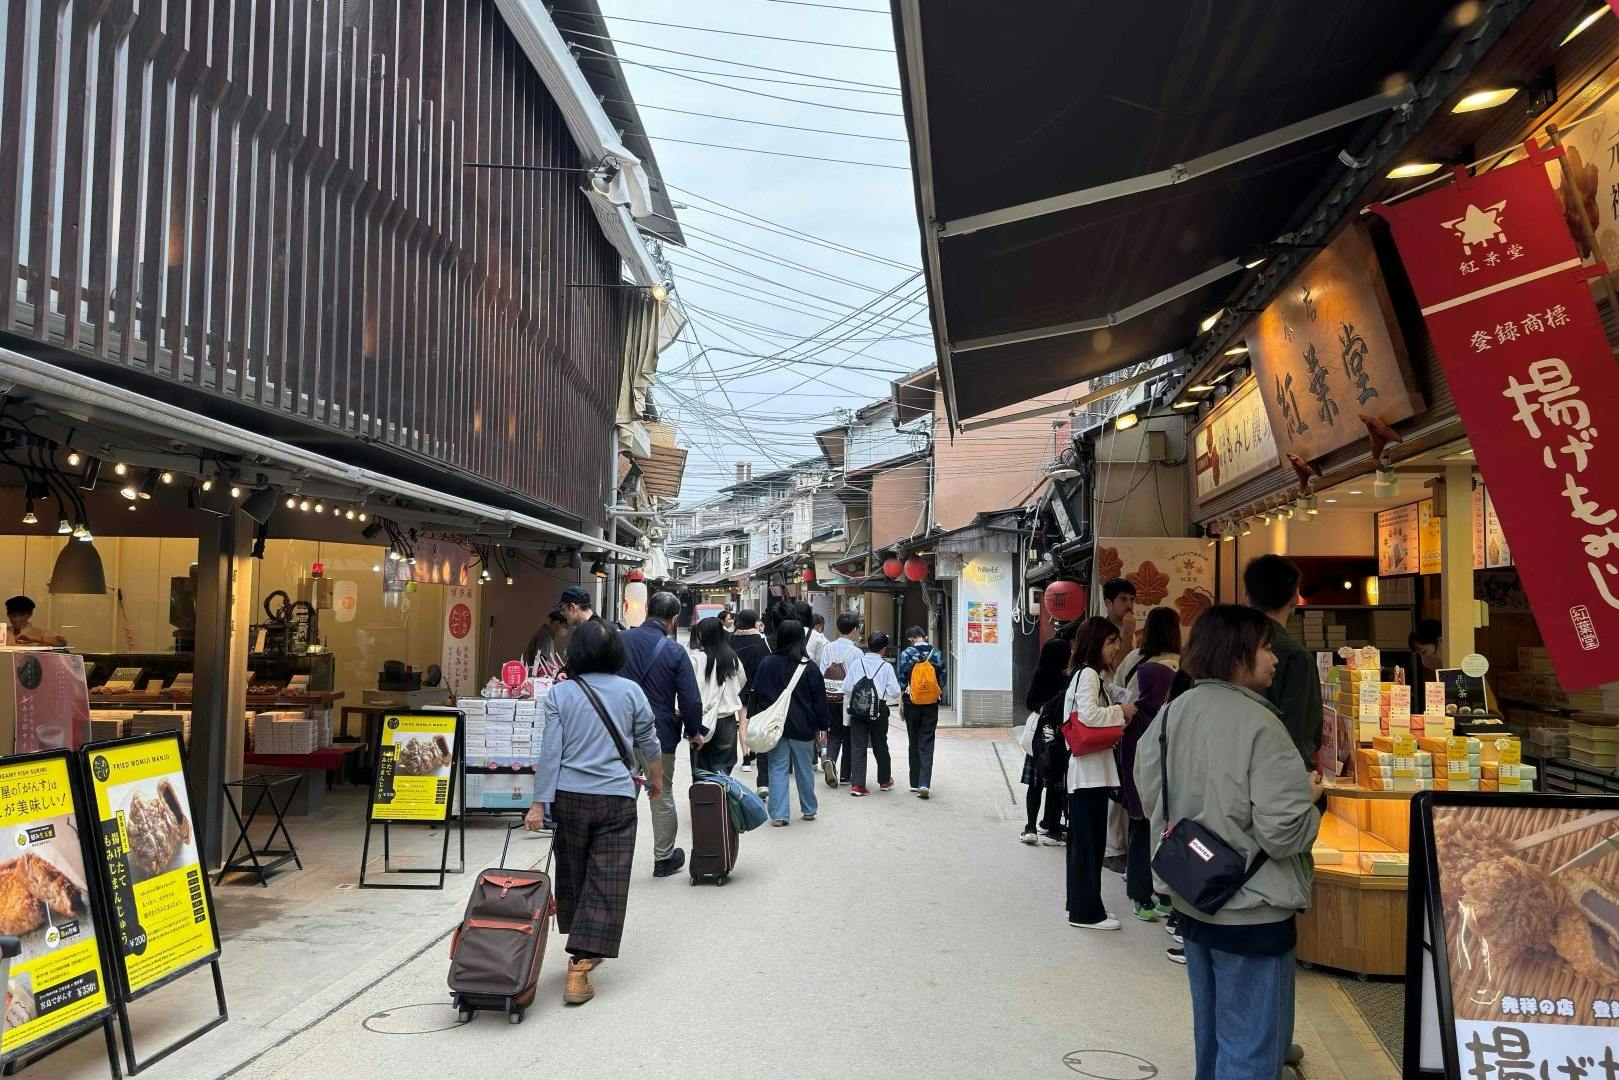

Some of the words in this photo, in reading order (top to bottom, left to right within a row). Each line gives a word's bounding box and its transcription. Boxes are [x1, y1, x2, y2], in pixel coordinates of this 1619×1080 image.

[1460, 246, 1527, 276] 紅葉堂
[1469, 304, 1572, 353] 登録商標
[1572, 606, 1598, 650] 紅葉堂
[18, 768, 31, 777] FISH
[113, 761, 130, 770] FRIED
[130, 757, 151, 768] MOMIJI
[151, 754, 170, 763] MANJU
[0, 792, 66, 818] が美味しい!
[111, 831, 127, 888] 揚げたて
[1193, 841, 1211, 858] HUNTER
[103, 834, 129, 945] もみじまんじゅう
[128, 934, 146, 948] ¥200
[1501, 994, 1576, 1018] 発祥の店
